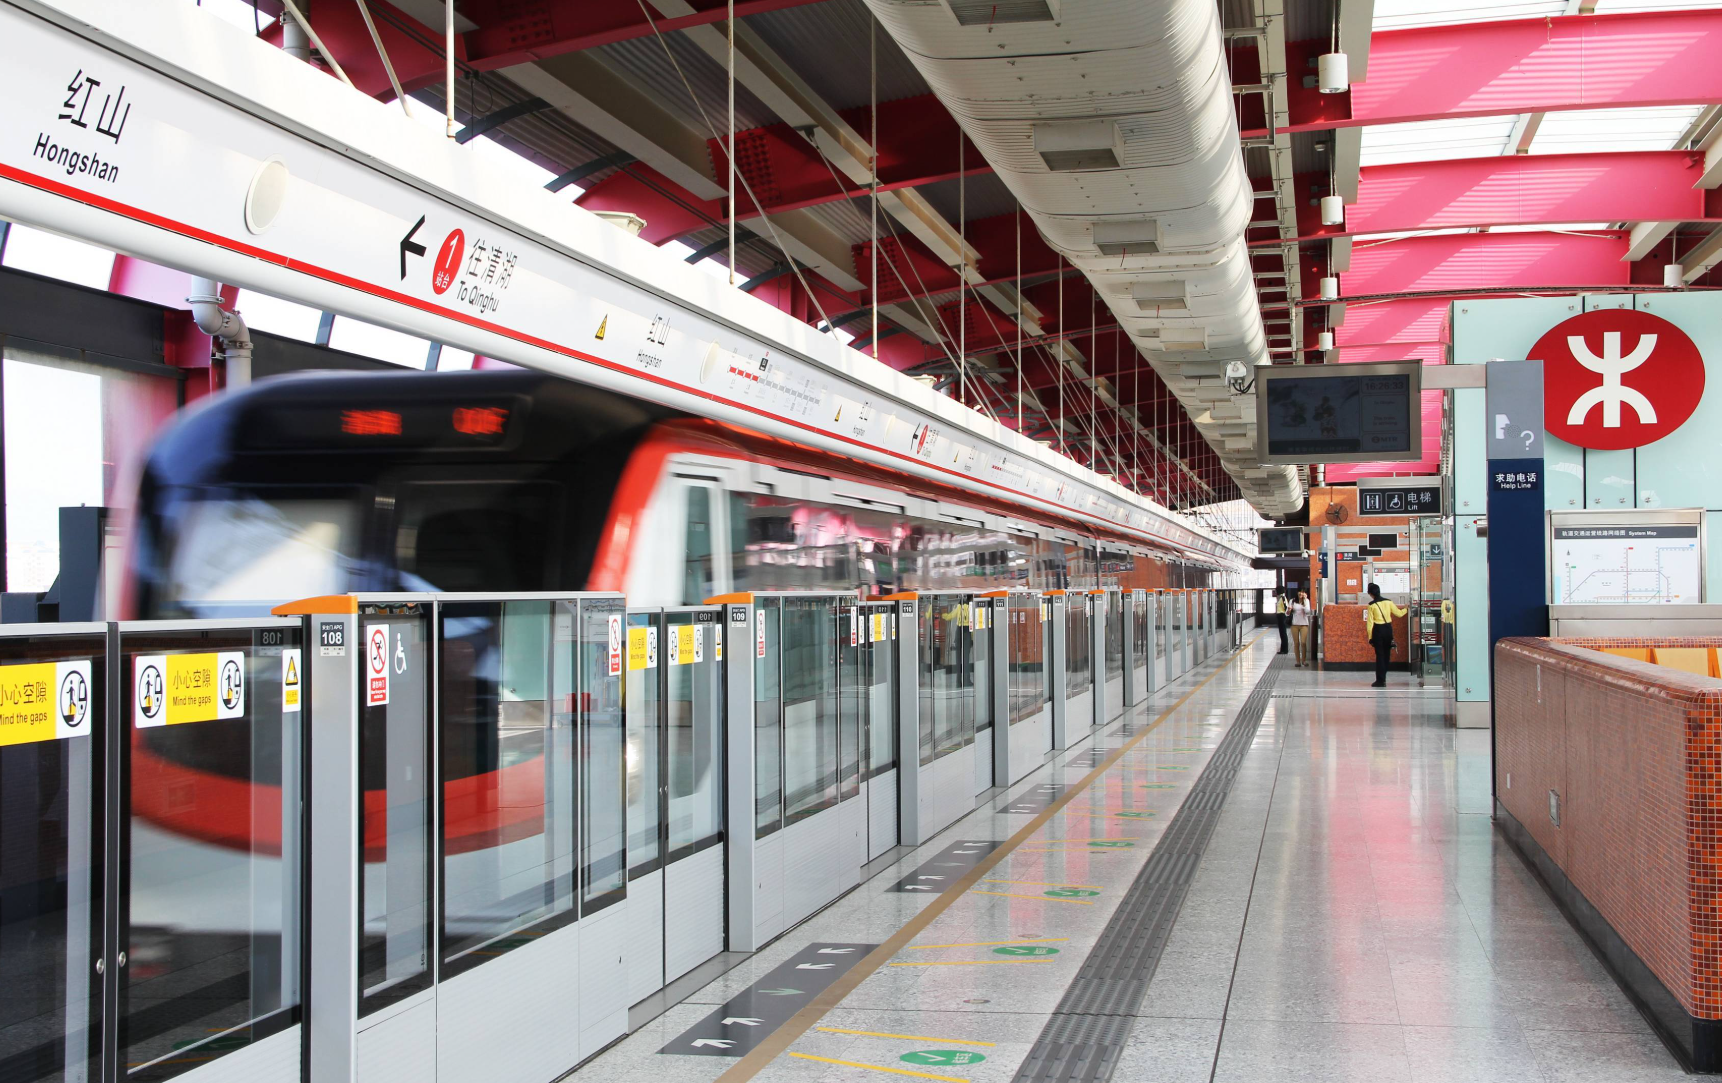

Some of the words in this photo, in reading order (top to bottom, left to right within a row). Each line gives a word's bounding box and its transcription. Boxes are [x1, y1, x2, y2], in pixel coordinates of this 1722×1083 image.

[58, 68, 131, 144] 红山
[33, 132, 119, 183] Hongshan
[446, 234, 459, 269] 1
[466, 238, 518, 290] 往清湖
[457, 280, 468, 301] To
[468, 286, 499, 314] Qinghu
[1495, 472, 1537, 482] 求助电话
[1407, 491, 1432, 503] 电梯
[732, 612, 746, 621] 109
[322, 631, 343, 645] 108
[172, 668, 212, 690] 小心空隙
[172, 695, 186, 706] Mind
[187, 695, 197, 705] the
[197, 695, 211, 707] gaps
[16, 711, 28, 724] the
[30, 711, 47, 725] gaps
